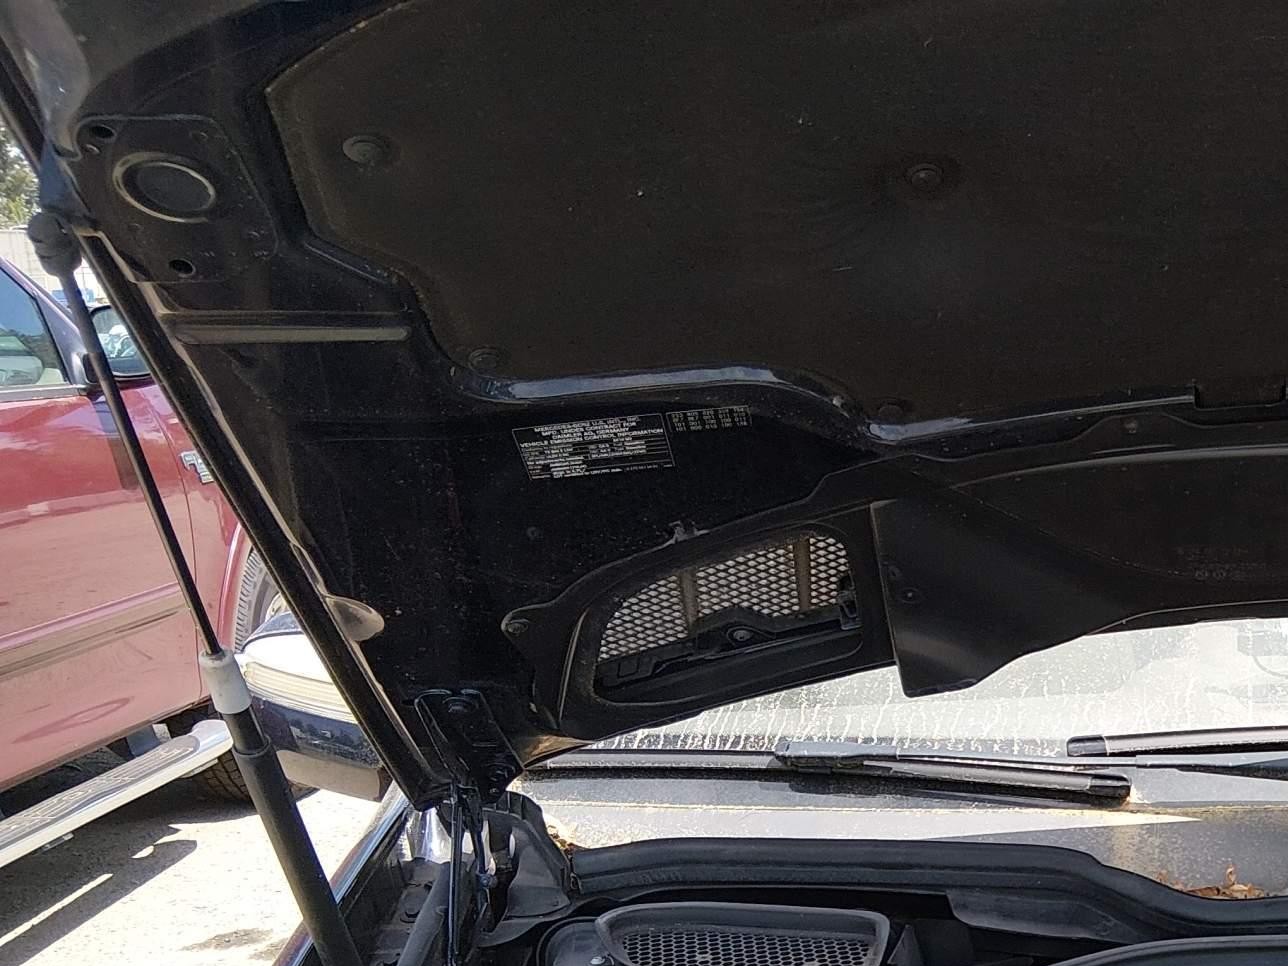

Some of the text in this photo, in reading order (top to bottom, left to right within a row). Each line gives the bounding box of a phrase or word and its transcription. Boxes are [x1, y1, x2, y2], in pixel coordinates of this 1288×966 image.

[552, 432, 582, 440] DAIMLER
[596, 427, 630, 435] GERMANY
[586, 423, 622, 431] CONTRACT
[520, 428, 664, 448] VEHICLE EMISSION CONTROL INFORMATION
